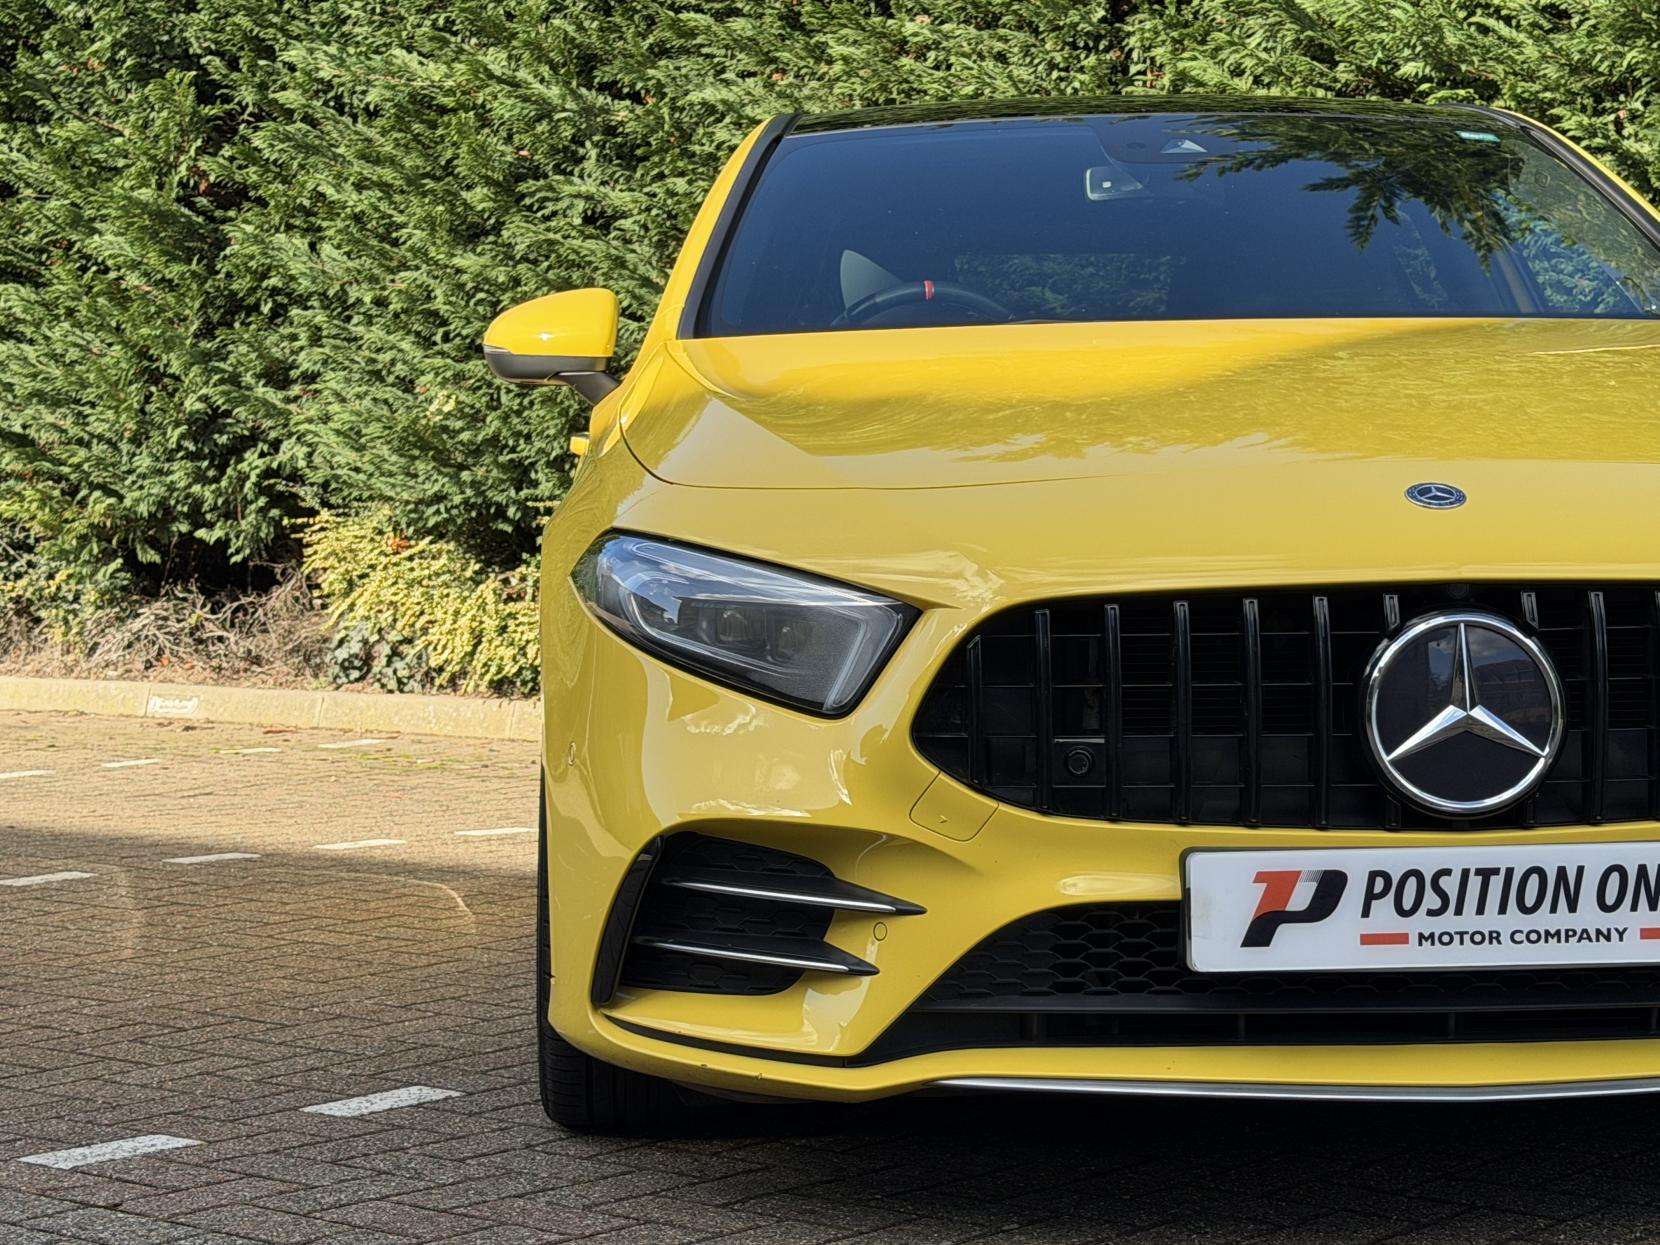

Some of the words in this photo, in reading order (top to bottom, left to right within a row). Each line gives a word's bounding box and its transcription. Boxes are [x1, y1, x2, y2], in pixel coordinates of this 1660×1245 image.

[1360, 864, 1585, 919] POSITION
[1418, 931, 1502, 947] MOTOR
[1509, 927, 1629, 945] COMPANY
